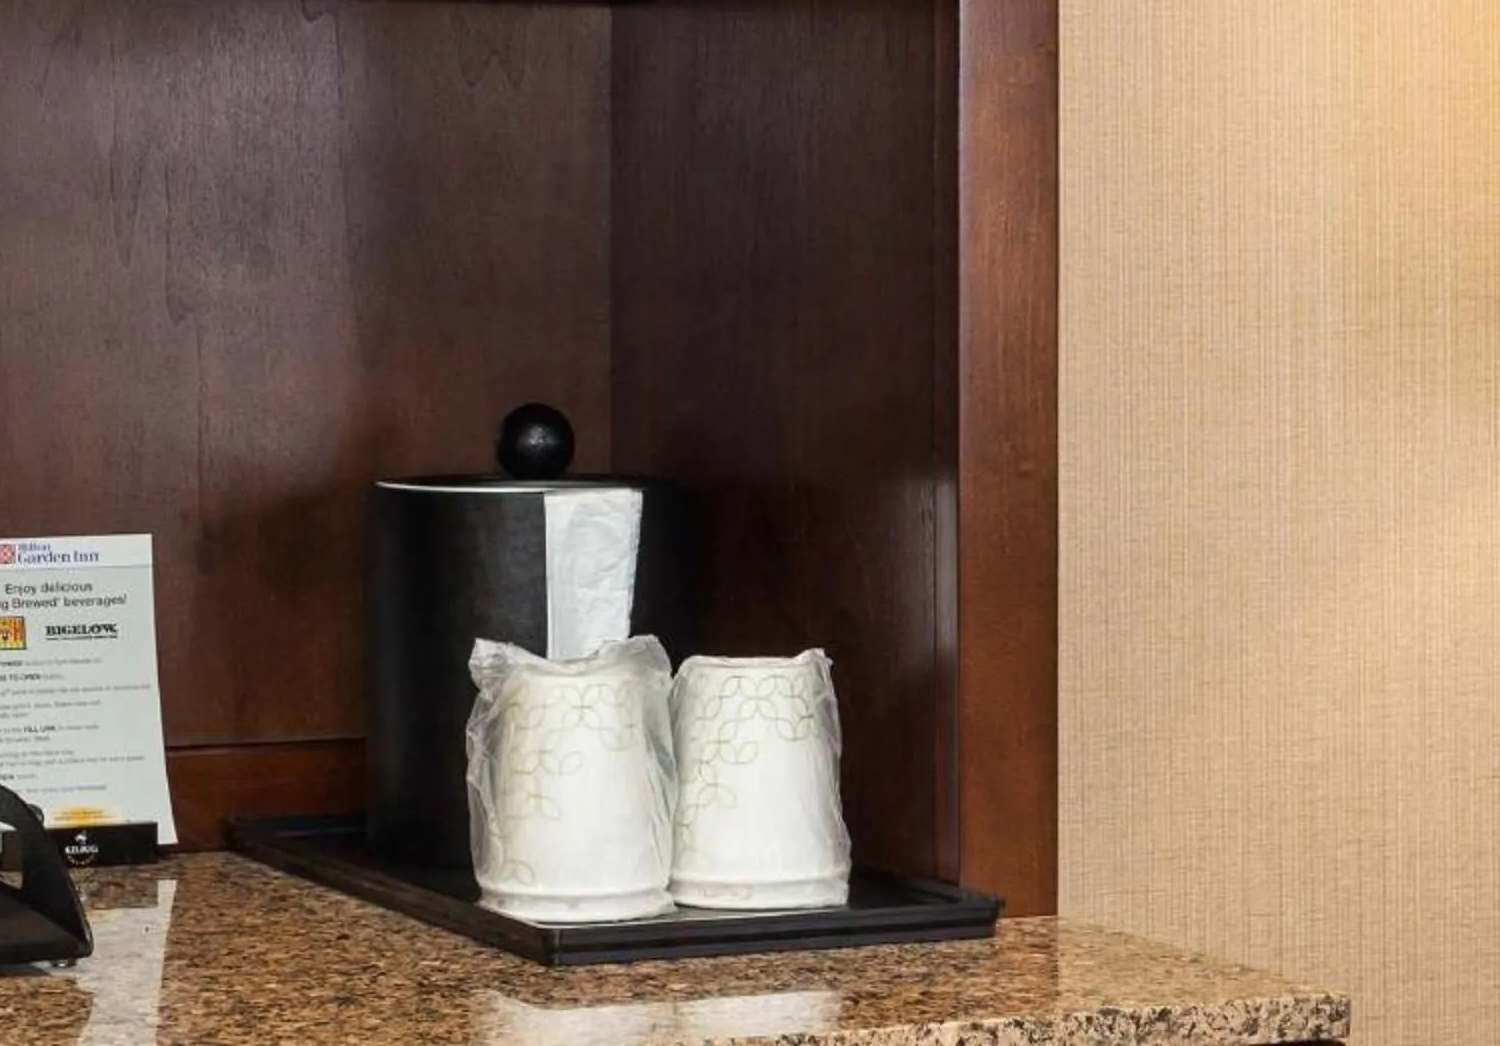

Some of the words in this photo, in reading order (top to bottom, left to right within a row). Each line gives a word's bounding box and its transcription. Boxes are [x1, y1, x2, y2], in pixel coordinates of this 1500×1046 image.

[17, 551, 71, 565] Garden
[73, 550, 100, 563] Inn
[5, 583, 37, 597] Enjoy
[40, 582, 93, 594] delicious
[63, 593, 127, 608] beverages!
[45, 623, 118, 636] BIGELOW
